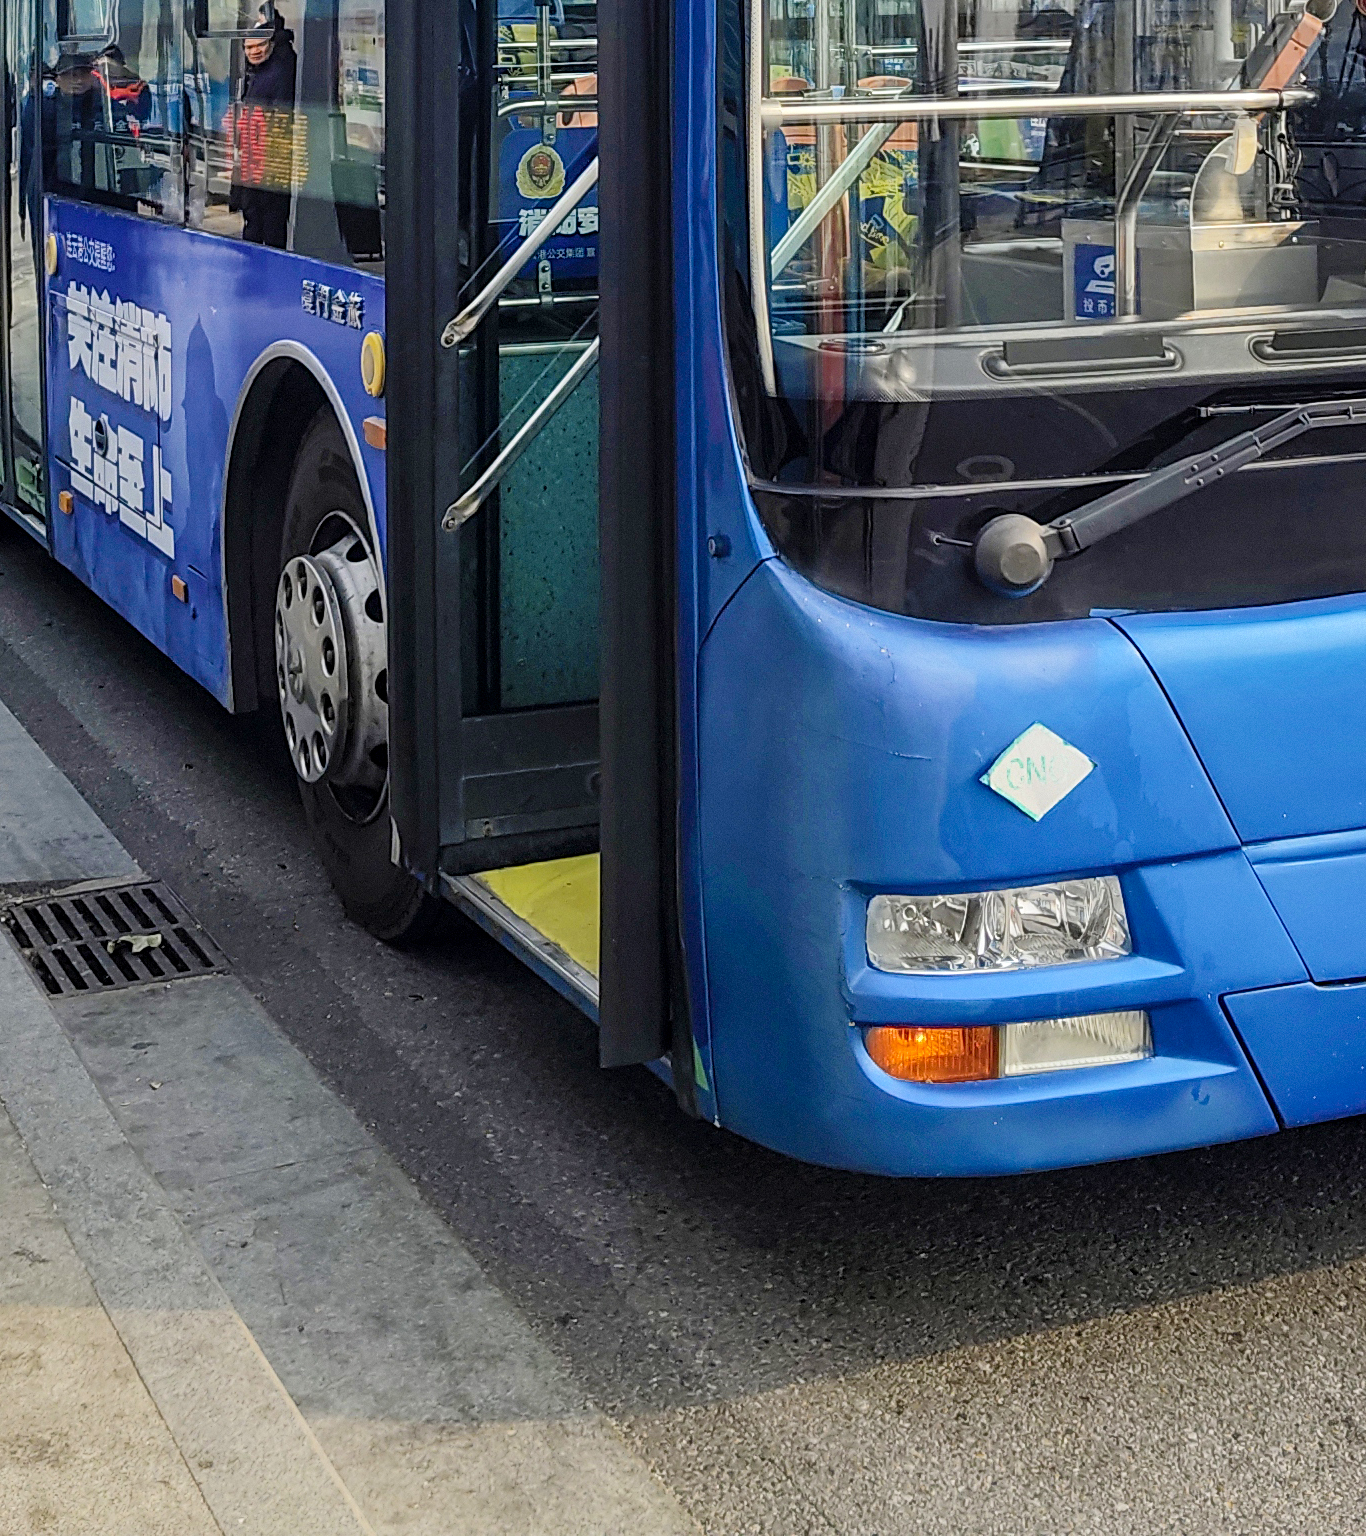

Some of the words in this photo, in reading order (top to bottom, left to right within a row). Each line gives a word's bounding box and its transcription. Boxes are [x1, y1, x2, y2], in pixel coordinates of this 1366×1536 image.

[66, 280, 172, 422] 关注消防
[68, 395, 175, 560] 生命至上
